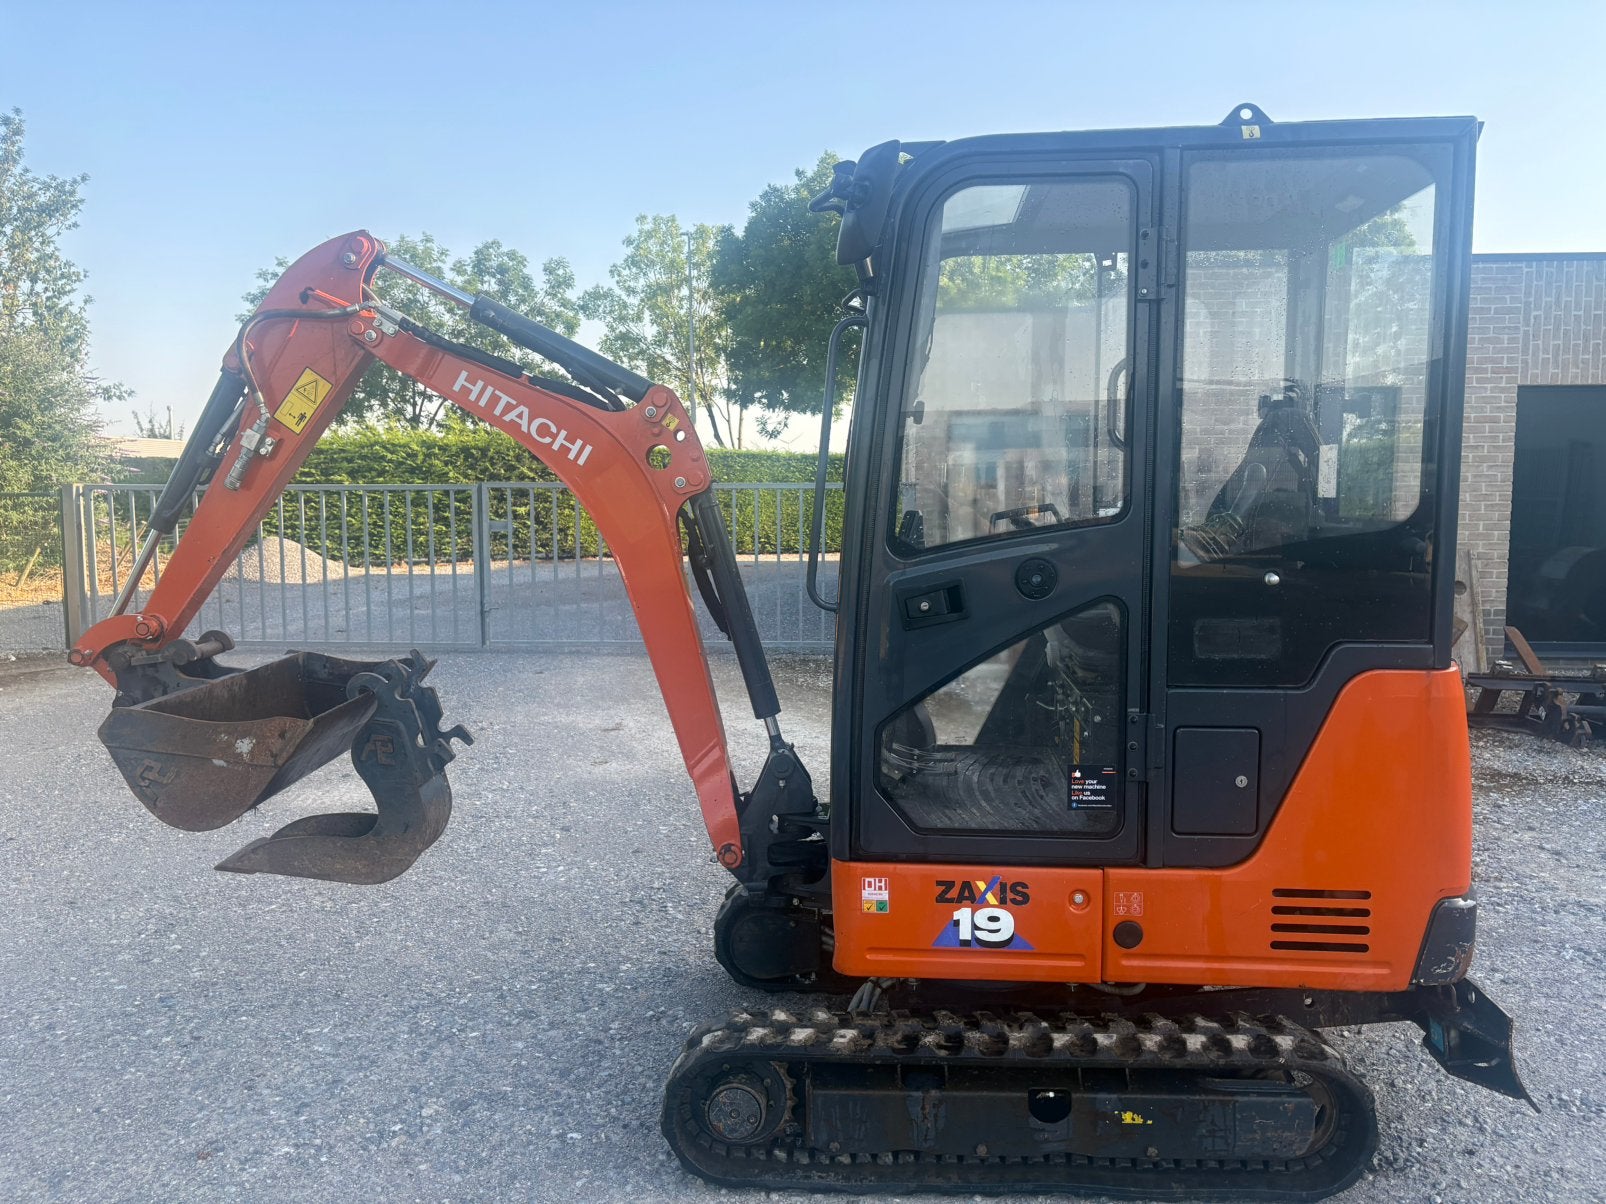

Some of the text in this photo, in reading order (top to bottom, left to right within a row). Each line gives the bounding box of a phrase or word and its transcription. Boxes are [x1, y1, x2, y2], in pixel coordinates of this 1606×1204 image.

[452, 370, 593, 466] HITACHI
[935, 876, 1031, 906] ZAXIS
[953, 907, 1015, 949] 19
